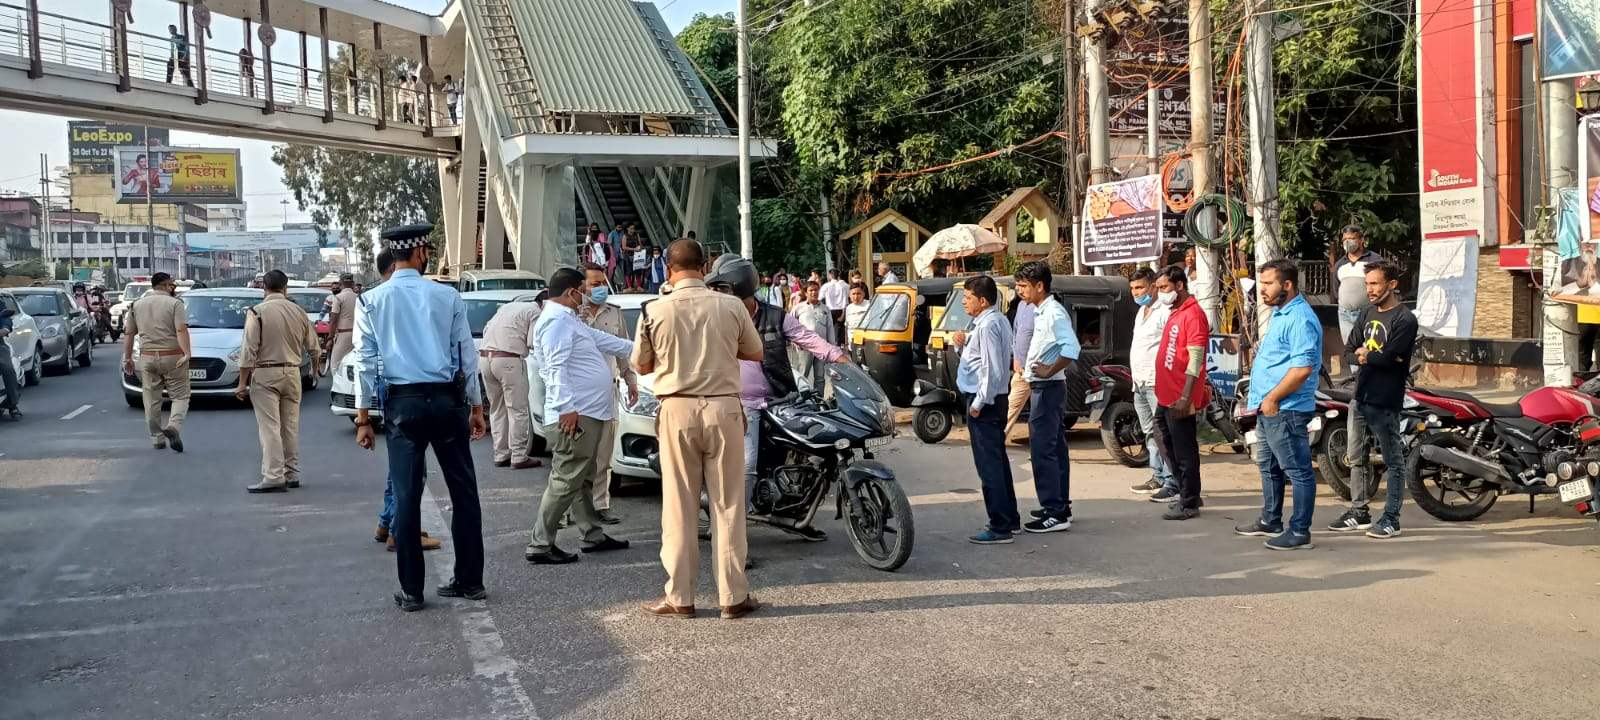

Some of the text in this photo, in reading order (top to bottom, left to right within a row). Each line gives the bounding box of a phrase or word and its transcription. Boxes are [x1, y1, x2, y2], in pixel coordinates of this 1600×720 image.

[1109, 99, 1145, 110] PRIME
[1159, 100, 1191, 112] ENTAL
[73, 129, 133, 144] LeoExpo
[80, 148, 91, 156] Oct
[92, 148, 100, 156] To
[1165, 325, 1179, 370] zomato
